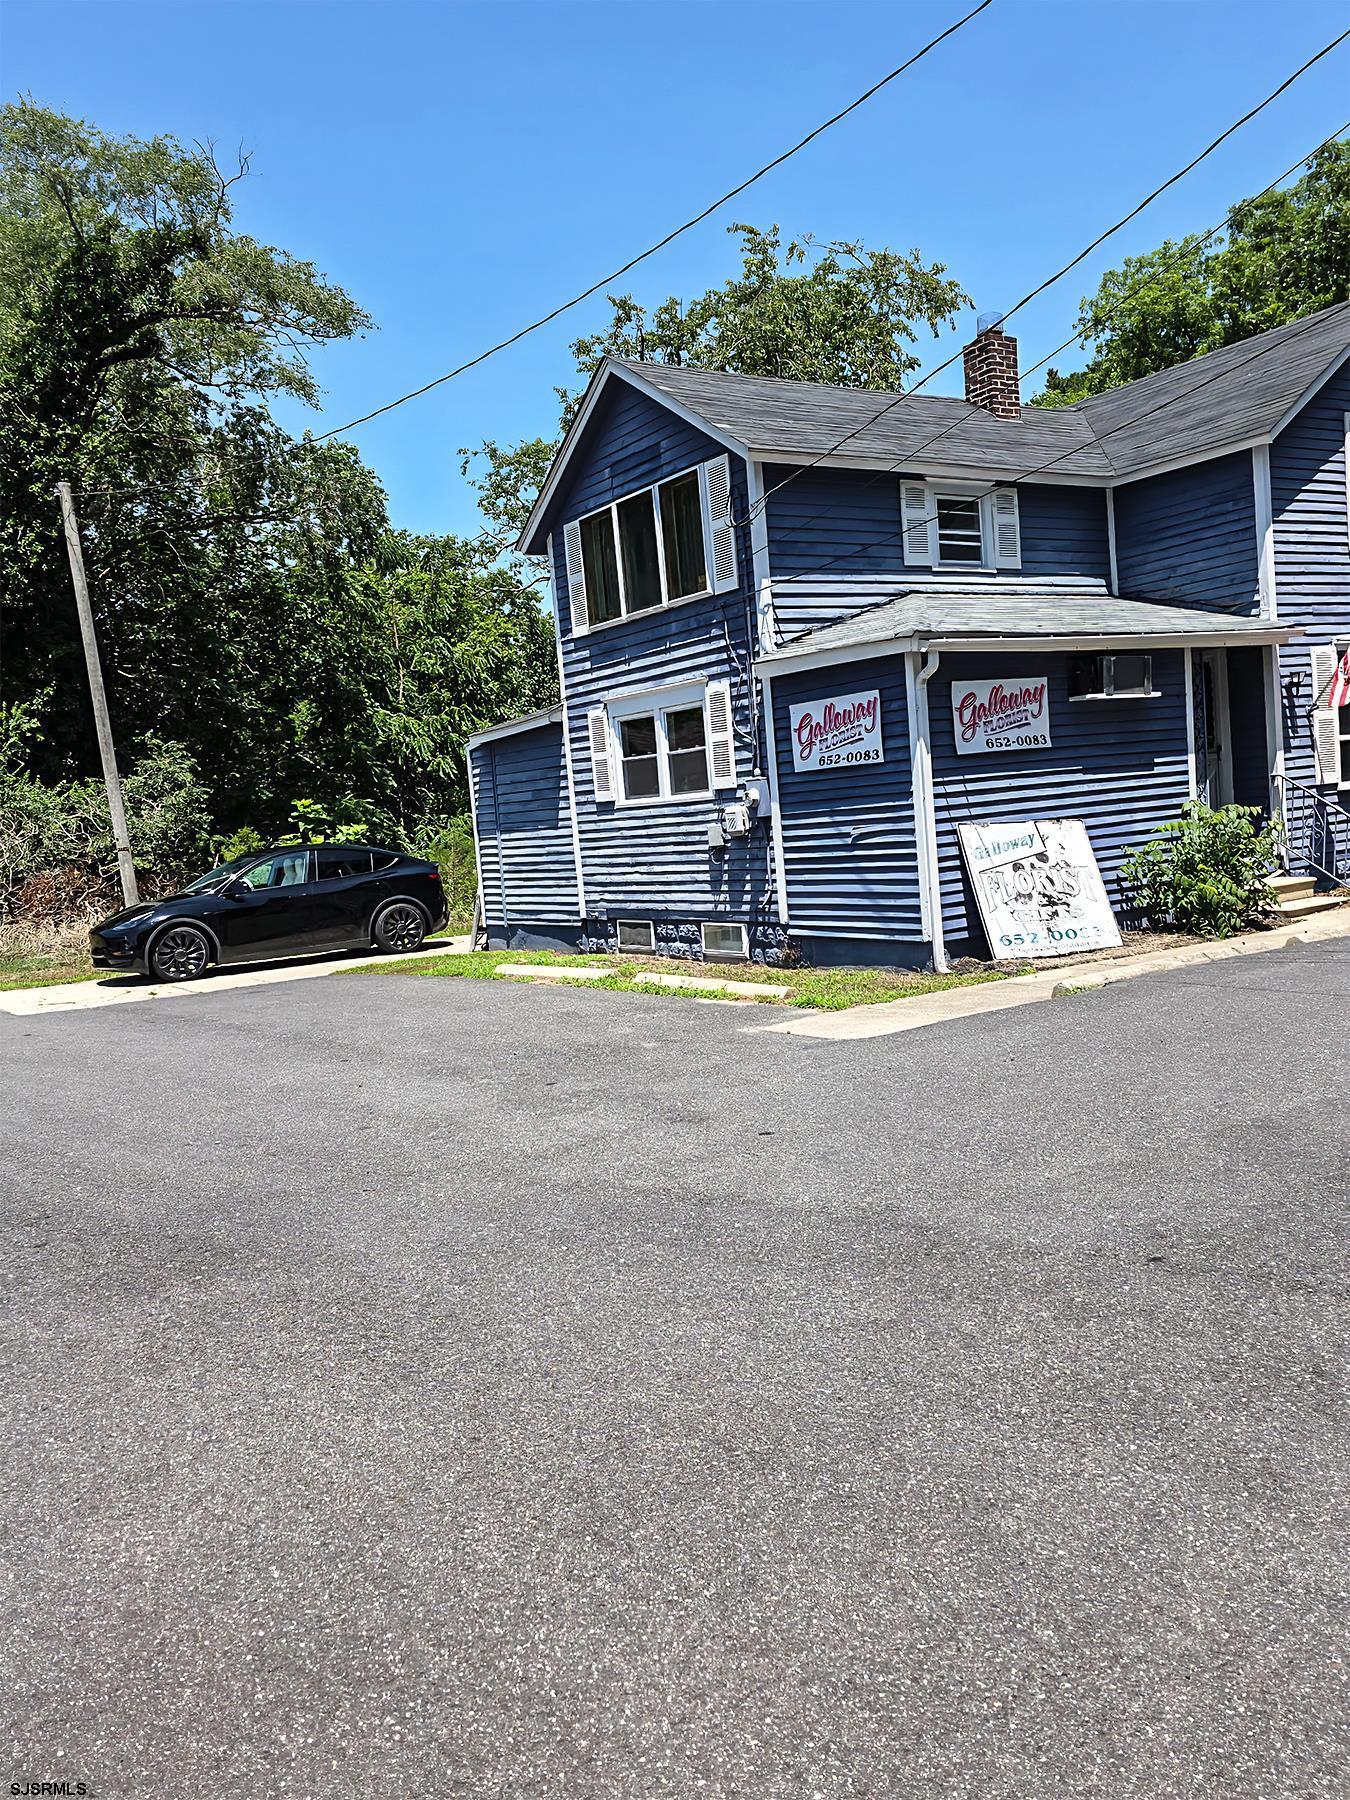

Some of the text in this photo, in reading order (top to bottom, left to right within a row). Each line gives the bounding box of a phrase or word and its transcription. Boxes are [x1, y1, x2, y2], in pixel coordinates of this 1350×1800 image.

[954, 684, 1046, 742] Galloway
[983, 710, 1031, 734] FLORIST
[793, 696, 879, 761] Galloway
[818, 724, 865, 751] FLORIST
[985, 734, 1048, 750] 652-0083
[818, 749, 880, 767] 652-0083
